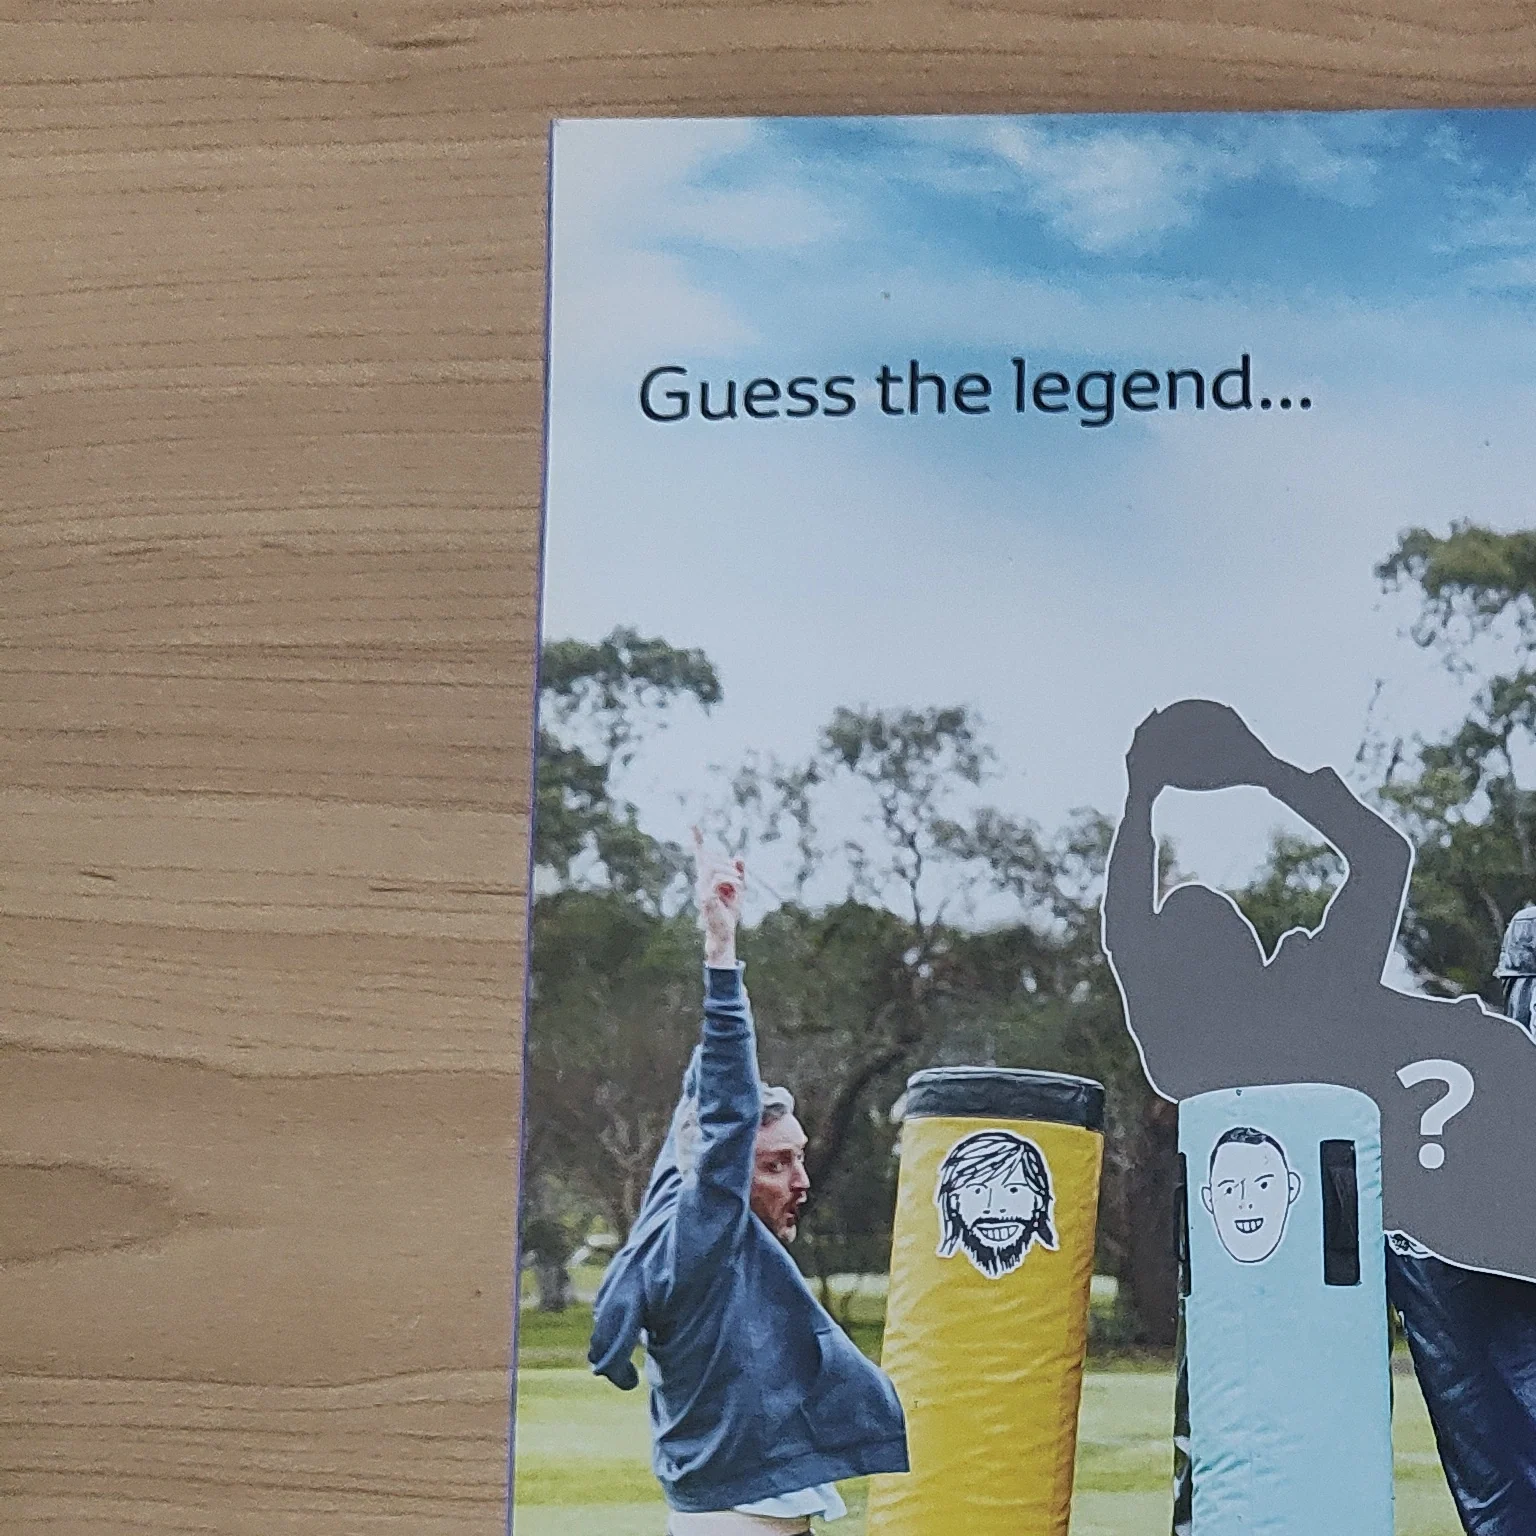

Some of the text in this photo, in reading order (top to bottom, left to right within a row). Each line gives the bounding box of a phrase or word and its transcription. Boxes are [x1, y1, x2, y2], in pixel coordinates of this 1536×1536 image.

[639, 353, 1312, 429] Guess the legend...
[1396, 1058, 1475, 1170] ?
